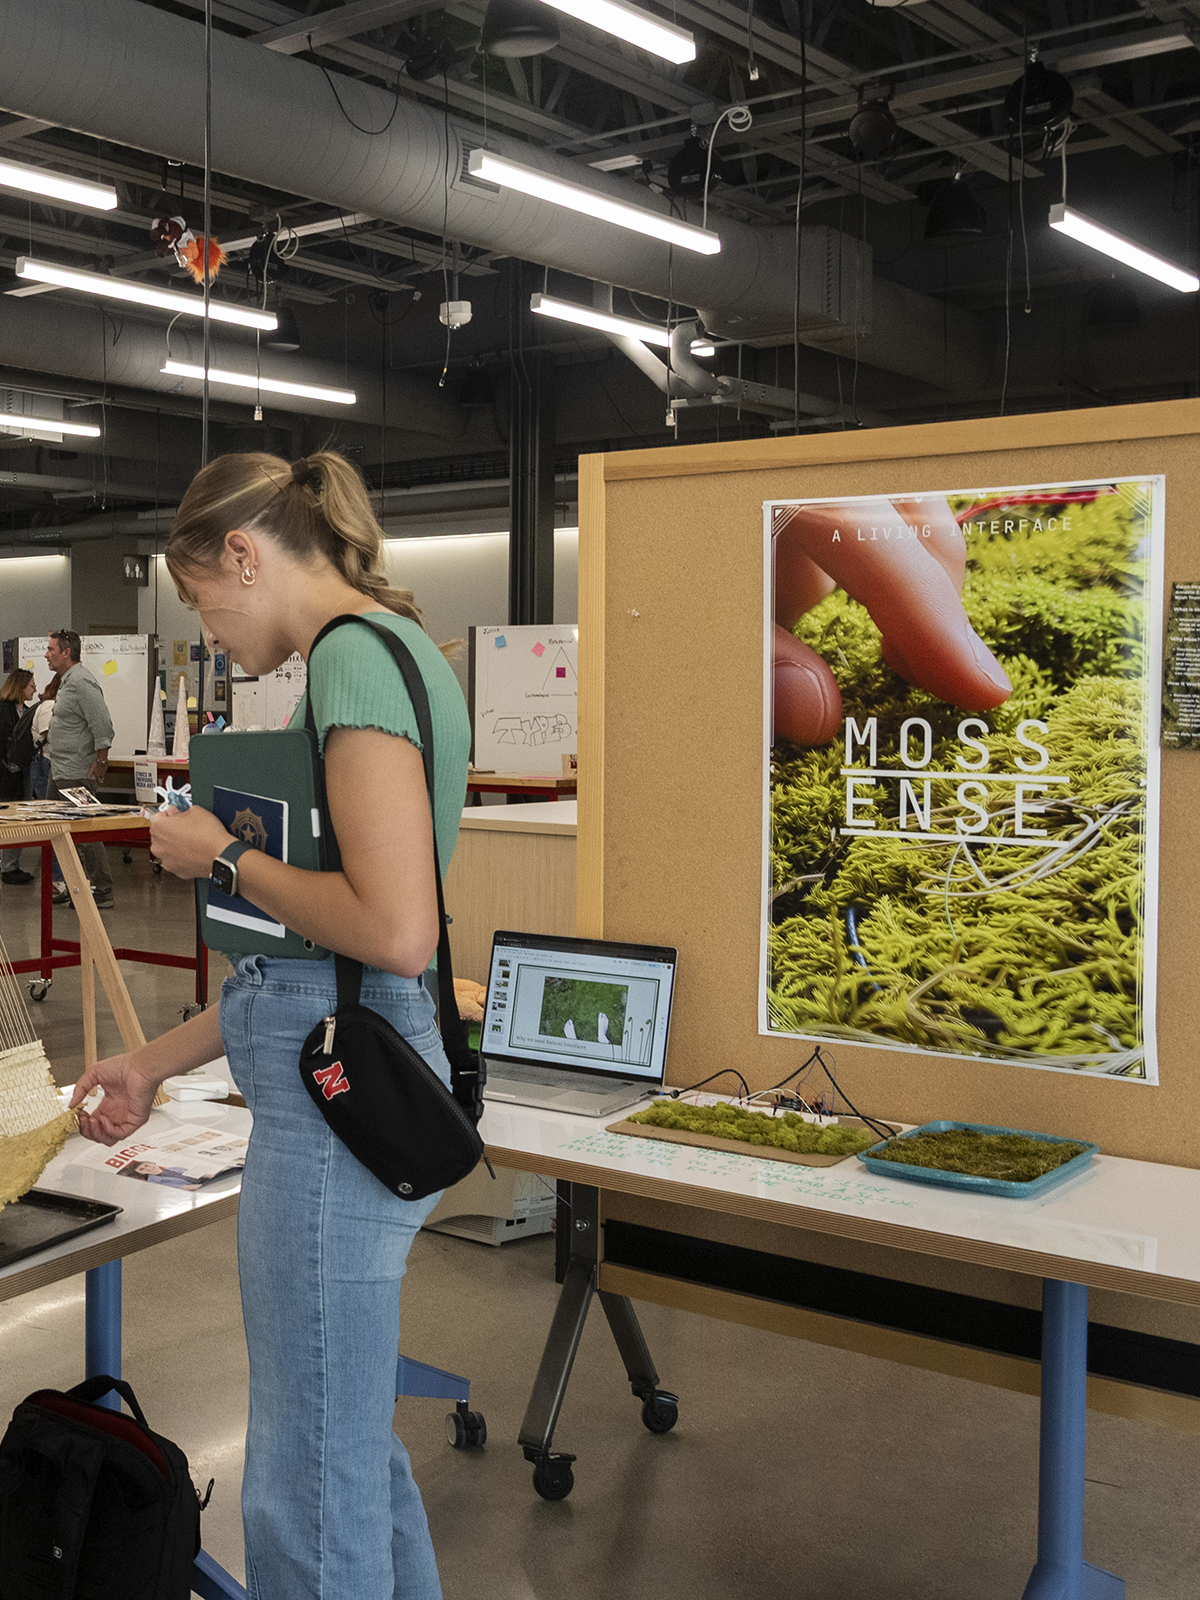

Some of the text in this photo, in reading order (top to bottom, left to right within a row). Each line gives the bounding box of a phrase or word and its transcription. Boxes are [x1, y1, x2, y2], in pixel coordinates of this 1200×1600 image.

[831, 517, 1073, 543] A LIVING INTERFACE
[845, 716, 1050, 773] MOSS
[845, 776, 1049, 837] ENSE
[312, 1060, 351, 1101] N
